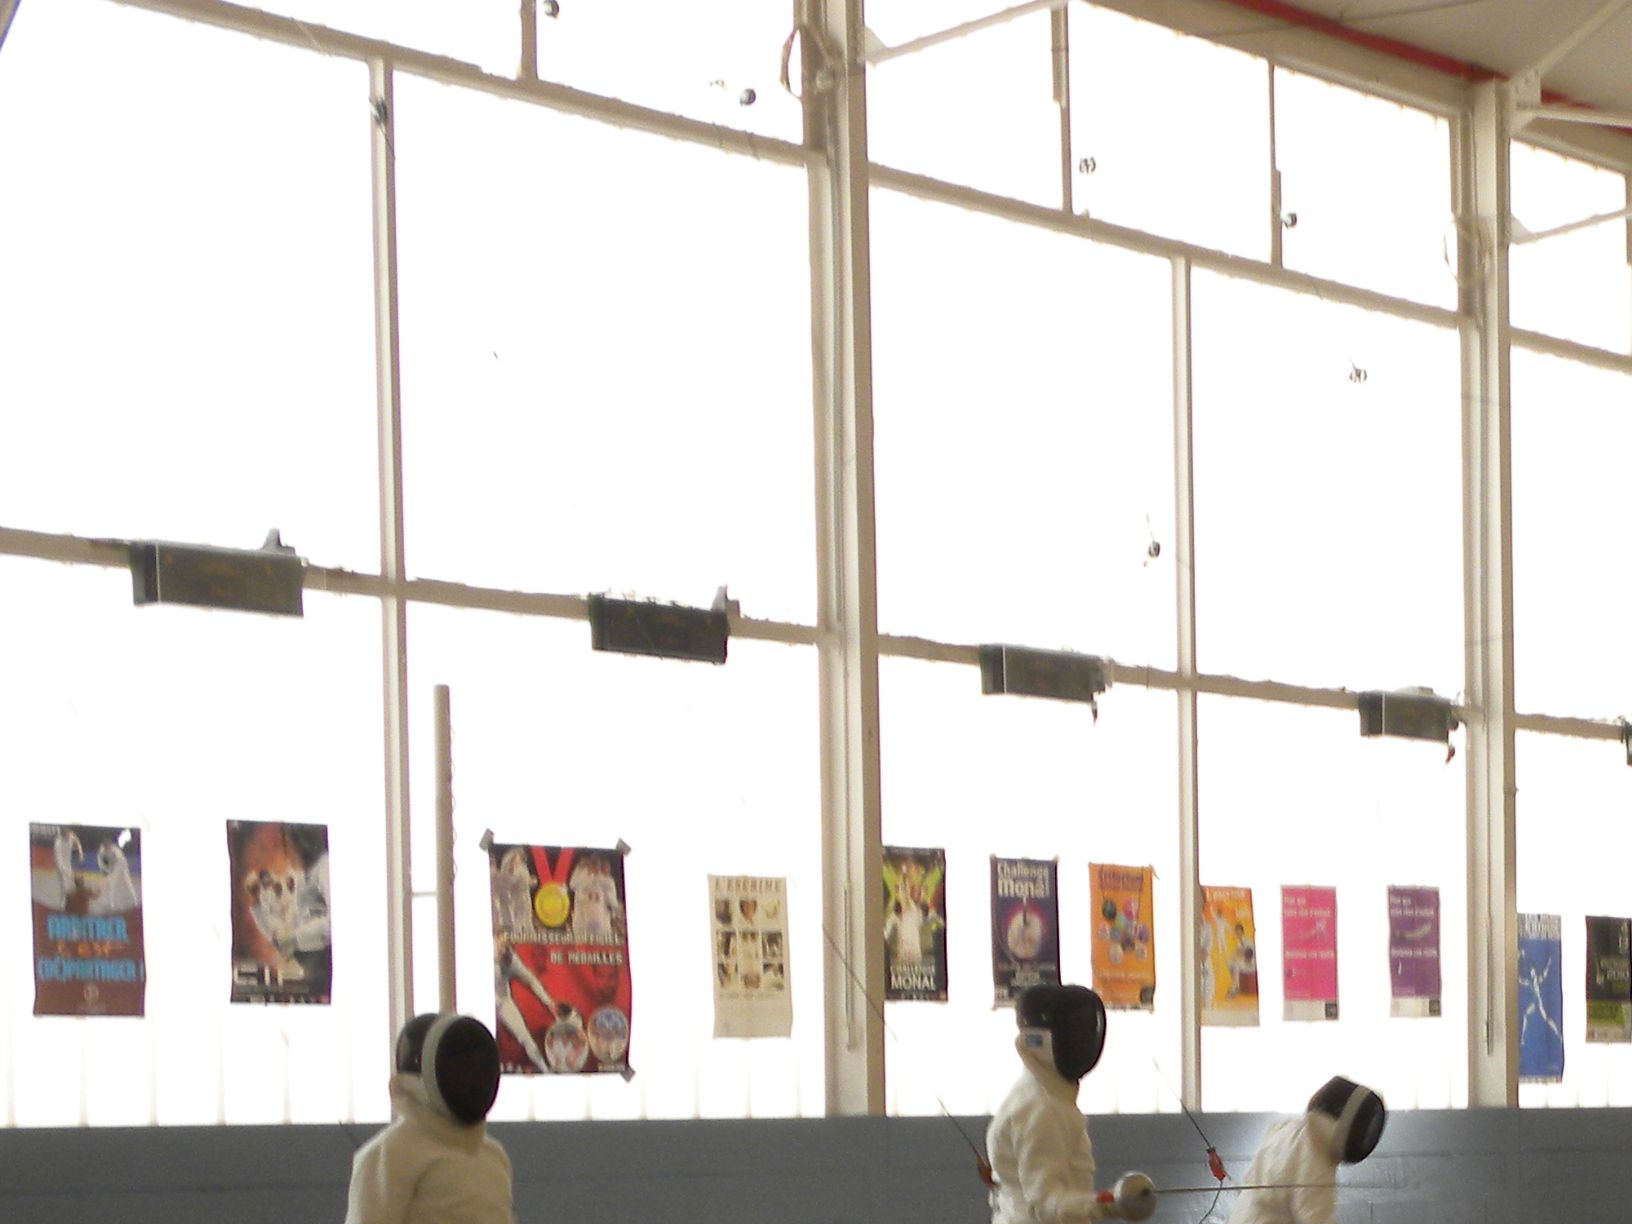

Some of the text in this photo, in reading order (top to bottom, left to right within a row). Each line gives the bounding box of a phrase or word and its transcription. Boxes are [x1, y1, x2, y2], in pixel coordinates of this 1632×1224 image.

[997, 861, 1049, 880] Challenge
[47, 914, 129, 942] ARBITRER
[550, 951, 563, 965] DE
[889, 964, 937, 977] CHALLENGE
[890, 974, 937, 992] MONAL
